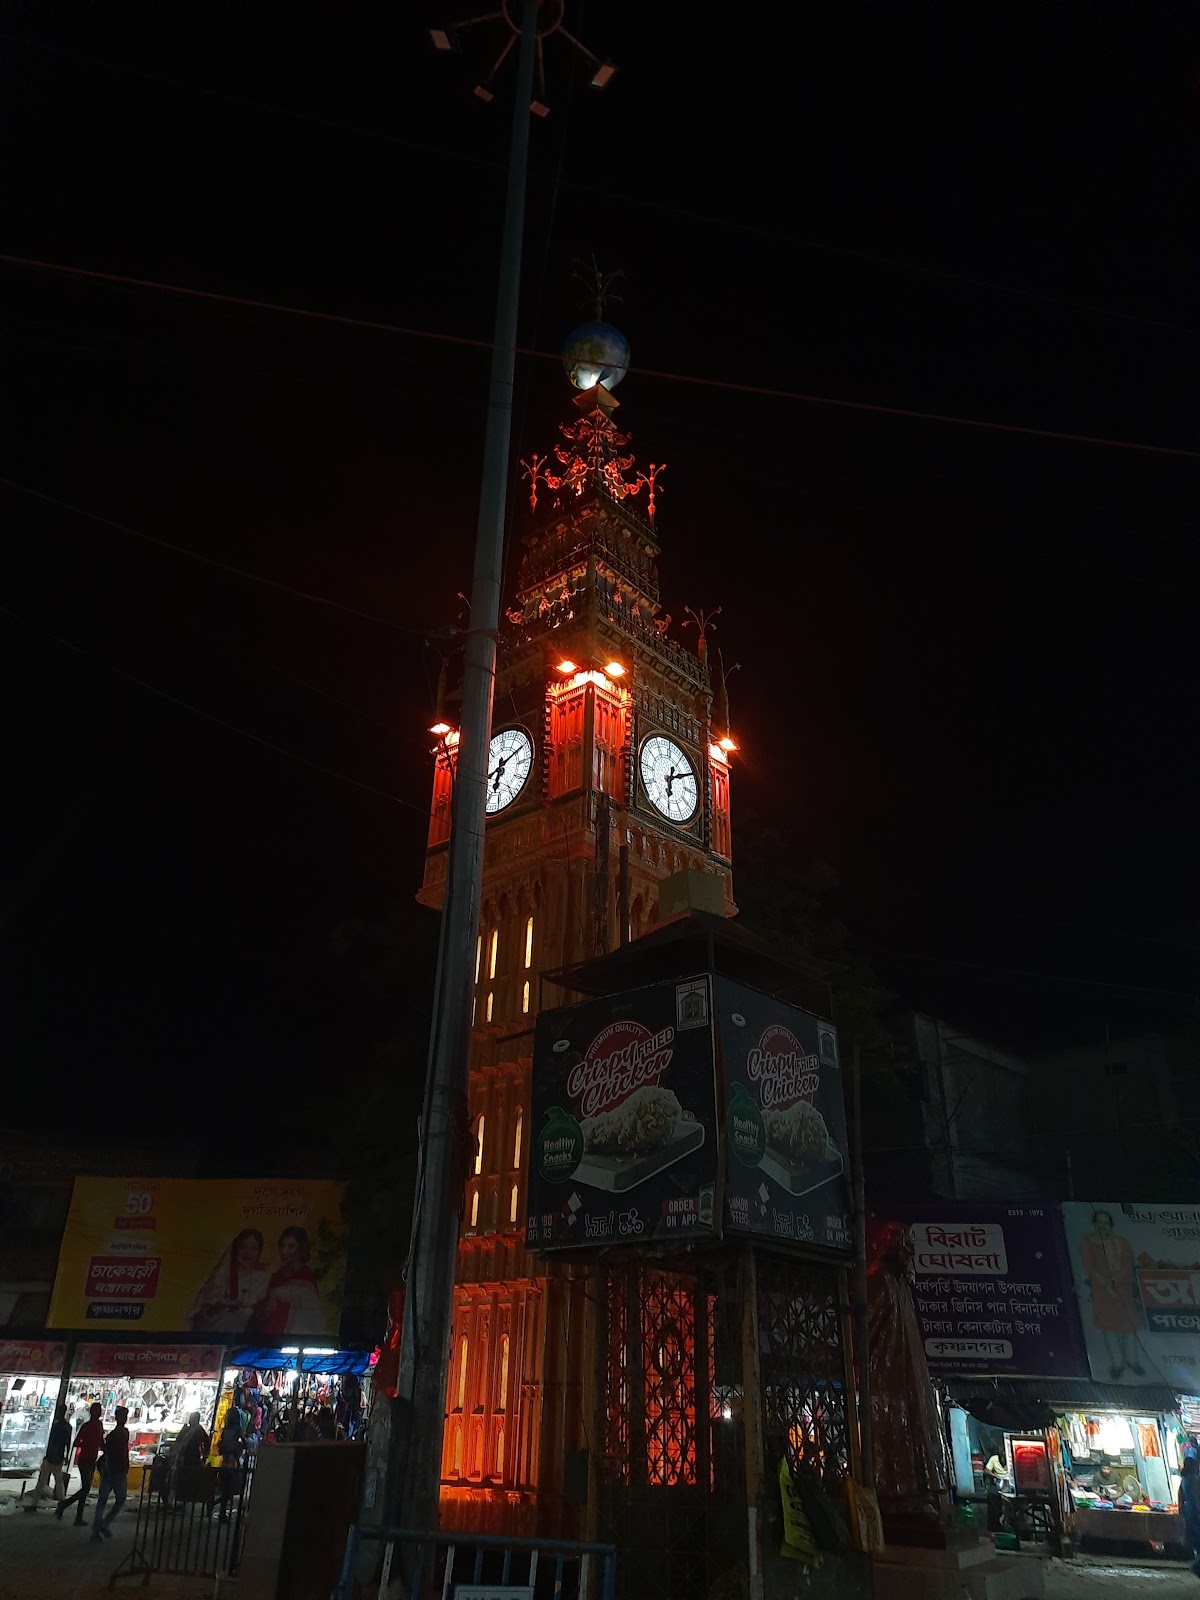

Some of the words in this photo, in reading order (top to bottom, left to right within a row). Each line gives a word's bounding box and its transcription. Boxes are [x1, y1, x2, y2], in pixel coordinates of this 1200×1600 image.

[588, 1028, 614, 1059] PREMIUM
[615, 1023, 644, 1037] QUALITY
[567, 1040, 638, 1097] Crispy
[638, 1027, 674, 1058] FRIED
[747, 1048, 797, 1081] Crispy
[796, 1055, 820, 1074] FRIED
[581, 1050, 673, 1118] Chicken
[760, 1073, 820, 1108] Chicken
[733, 1115, 759, 1137] Healthy
[544, 1136, 576, 1151] Healthy
[735, 1131, 758, 1148] Snacks
[543, 1151, 573, 1165] Snacks
[669, 1199, 694, 1212] ORDER
[528, 1214, 552, 1228] COBO
[666, 1215, 677, 1227] ON
[681, 1213, 697, 1226] APP
[730, 1210, 750, 1225] FFERS
[925, 1226, 986, 1248] বিরাট
[919, 1252, 1000, 1270] ঘোষনা
[917, 1297, 949, 1312] টাকার
[950, 1296, 984, 1313] জিনিস
[986, 1301, 1008, 1315] পান
[920, 1317, 953, 1333] টাকার
[957, 1319, 1013, 1334] কেনাকাটার
[1014, 1319, 1041, 1336] উপর
[931, 1341, 1005, 1354] কৃষ্ণনগর
